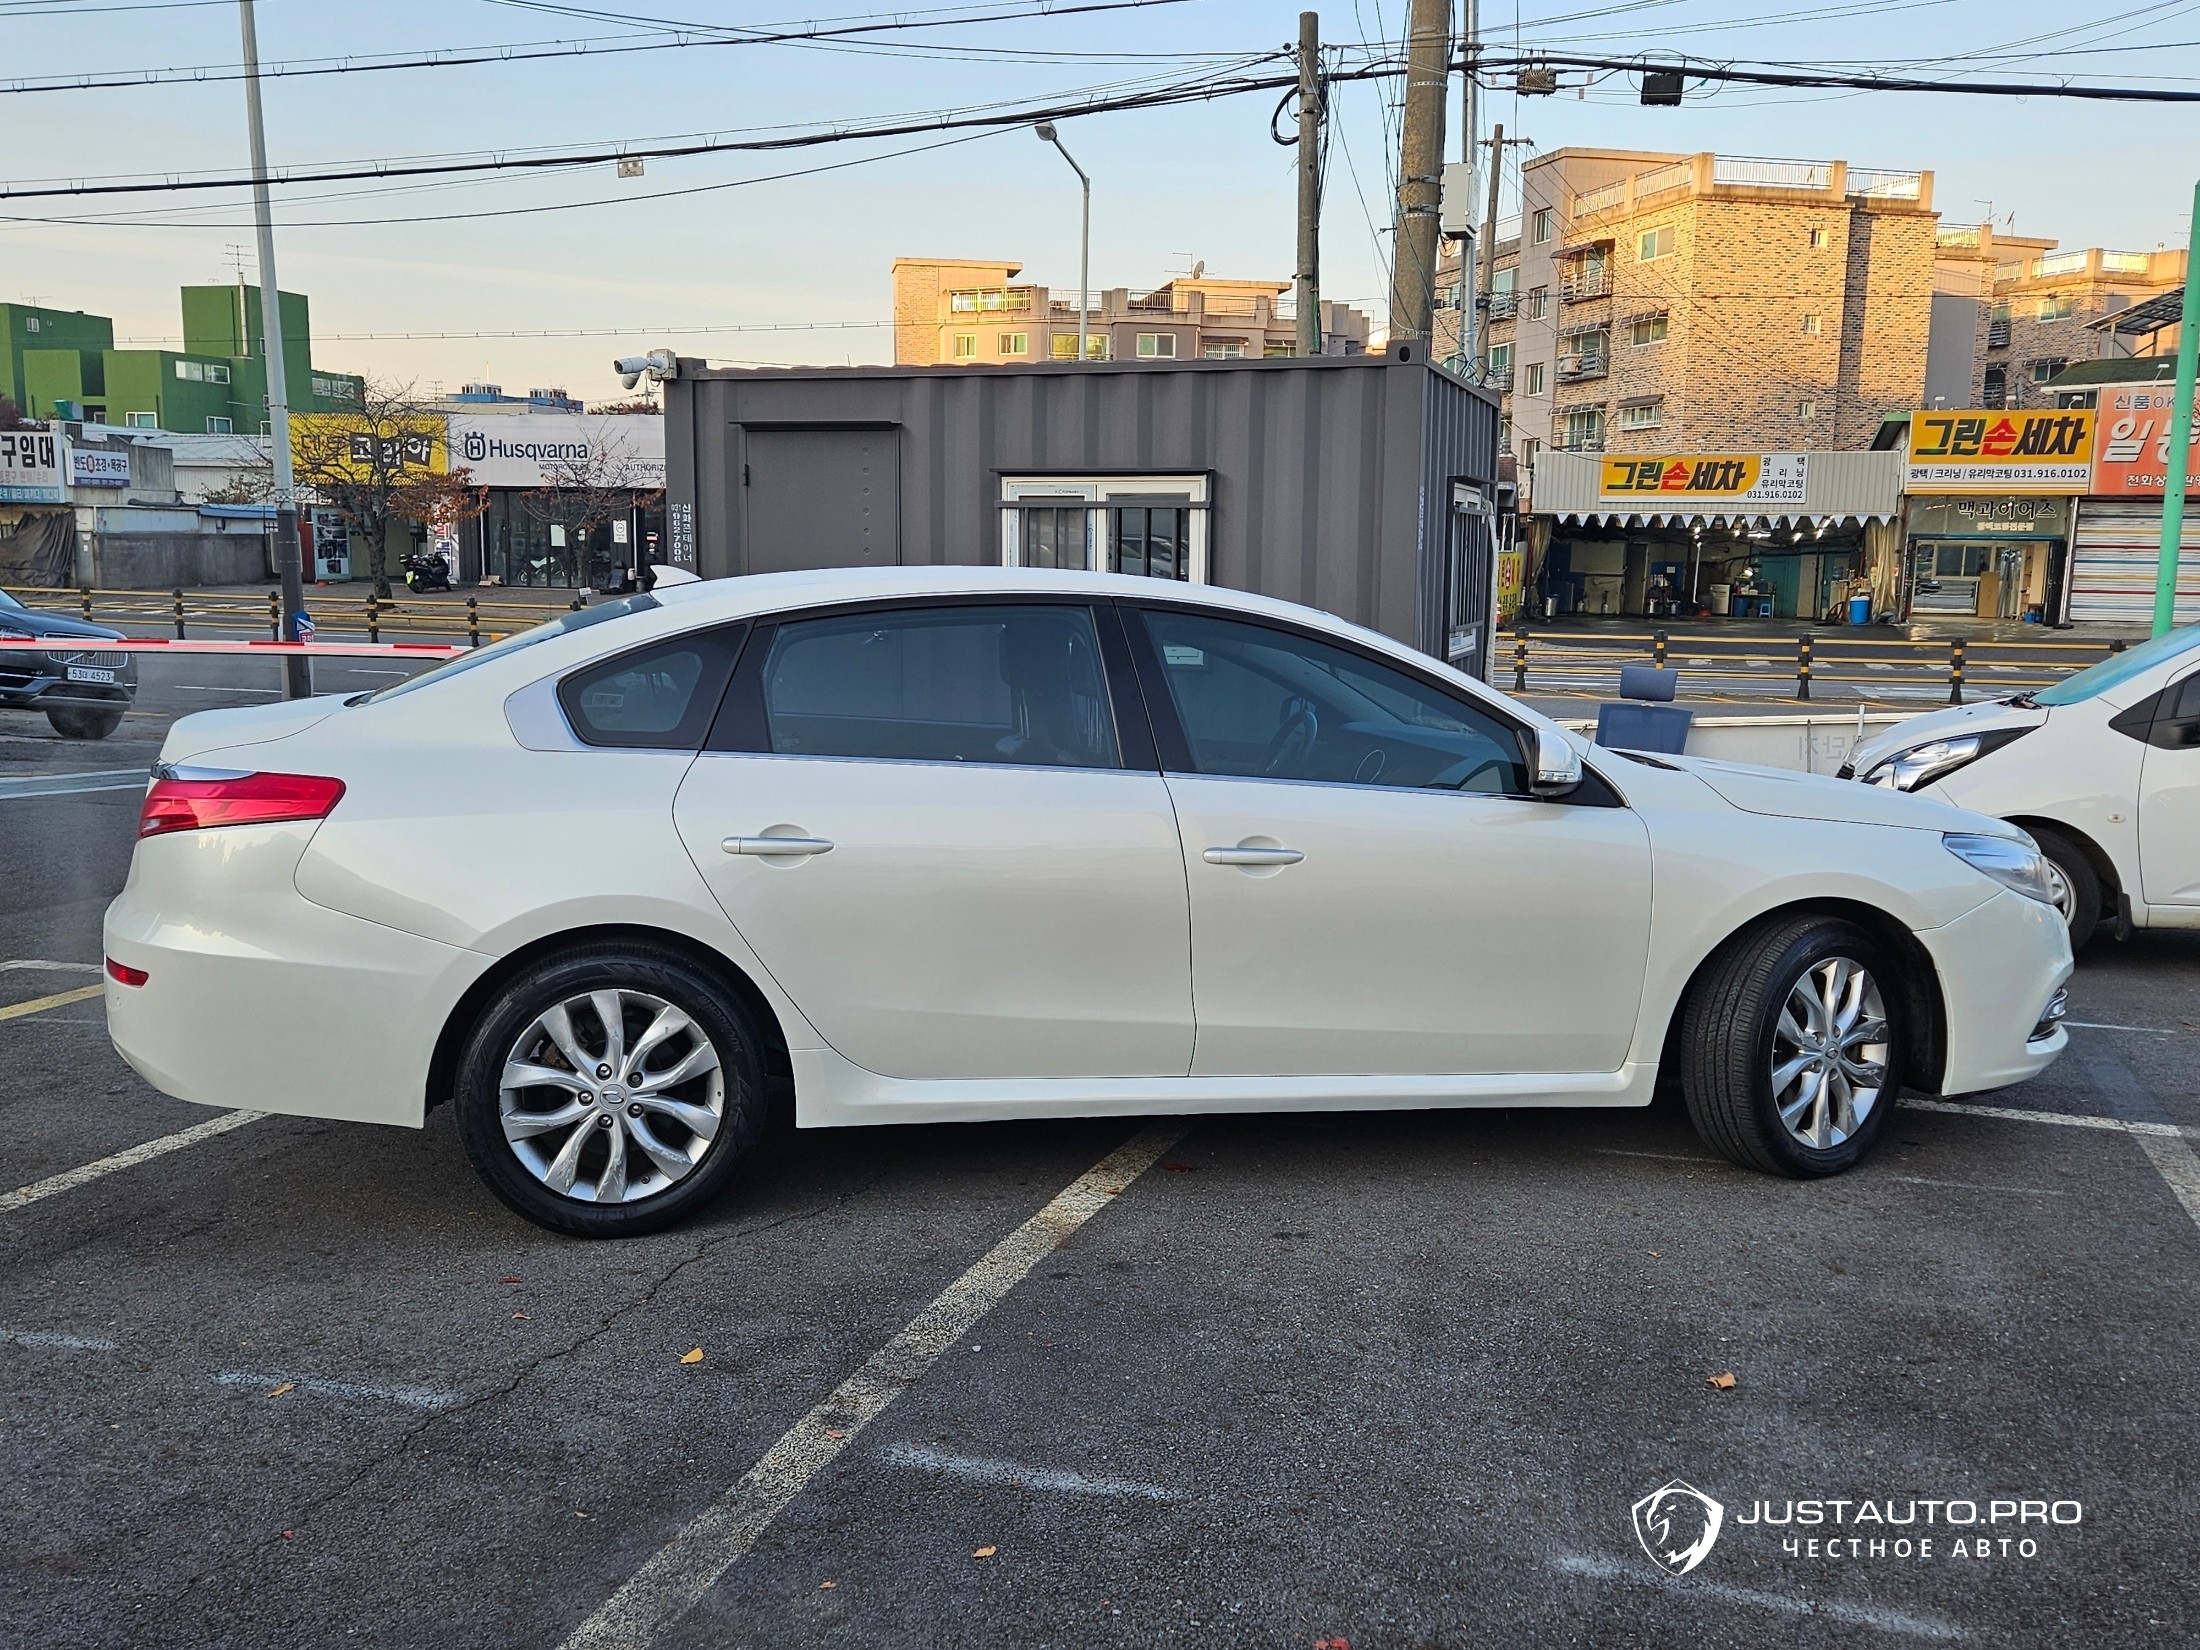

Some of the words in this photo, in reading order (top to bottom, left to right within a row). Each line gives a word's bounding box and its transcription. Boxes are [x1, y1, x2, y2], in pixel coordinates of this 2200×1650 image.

[1915, 416, 2087, 456] 그린손세차
[490, 440, 588, 461] Husqvarna
[1606, 461, 1746, 490] 그린손세차
[1968, 468, 2013, 479] 유리막코팅
[2014, 468, 2087, 479] 031.916.0102
[1761, 479, 1804, 489] 유리막코팅
[1747, 490, 1803, 499] 031.916.0102
[1957, 500, 2057, 520] 맥과이어스
[91, 671, 111, 681] 4523
